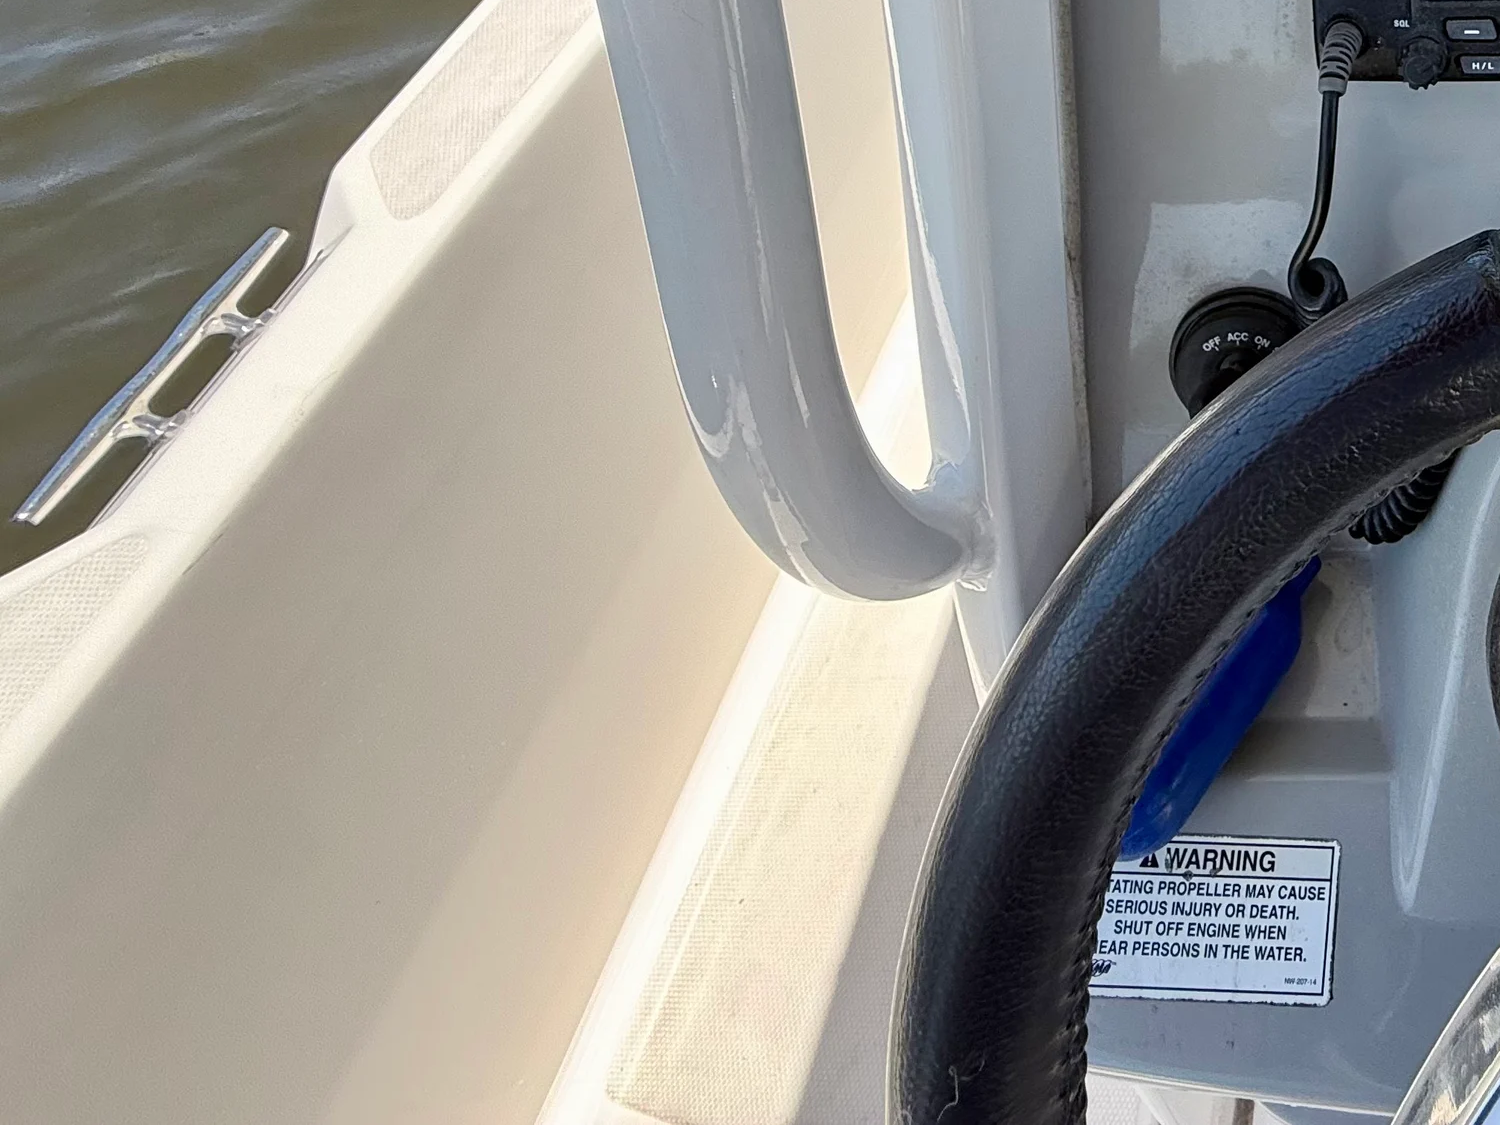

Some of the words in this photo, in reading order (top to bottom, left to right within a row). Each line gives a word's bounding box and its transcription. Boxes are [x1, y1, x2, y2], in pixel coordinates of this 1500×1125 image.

[1393, 19, 1410, 28] SQL
[1471, 61, 1495, 71] H/L
[1202, 335, 1222, 353] OFF
[1227, 331, 1249, 342] ACC
[1253, 335, 1271, 348] ON
[1166, 847, 1277, 873] WARNING
[1157, 880, 1241, 898] PROPELLER
[1245, 884, 1275, 899] MAY
[1278, 885, 1326, 901] CAUSE
[1105, 898, 1168, 915] SERIOUS
[1171, 901, 1222, 917] INJURY
[1225, 903, 1246, 918] OR
[1249, 904, 1300, 921] DEATH.
[1114, 919, 1153, 935] SHUT
[1155, 921, 1184, 937] OFF
[1187, 922, 1240, 939] ENGINE
[1244, 924, 1287, 940] WHEN
[1096, 939, 1128, 955] EAR
[1132, 941, 1200, 958] PERSONS
[1204, 944, 1219, 959] IN
[1222, 944, 1250, 960] THE
[1254, 946, 1307, 963] WATER.
